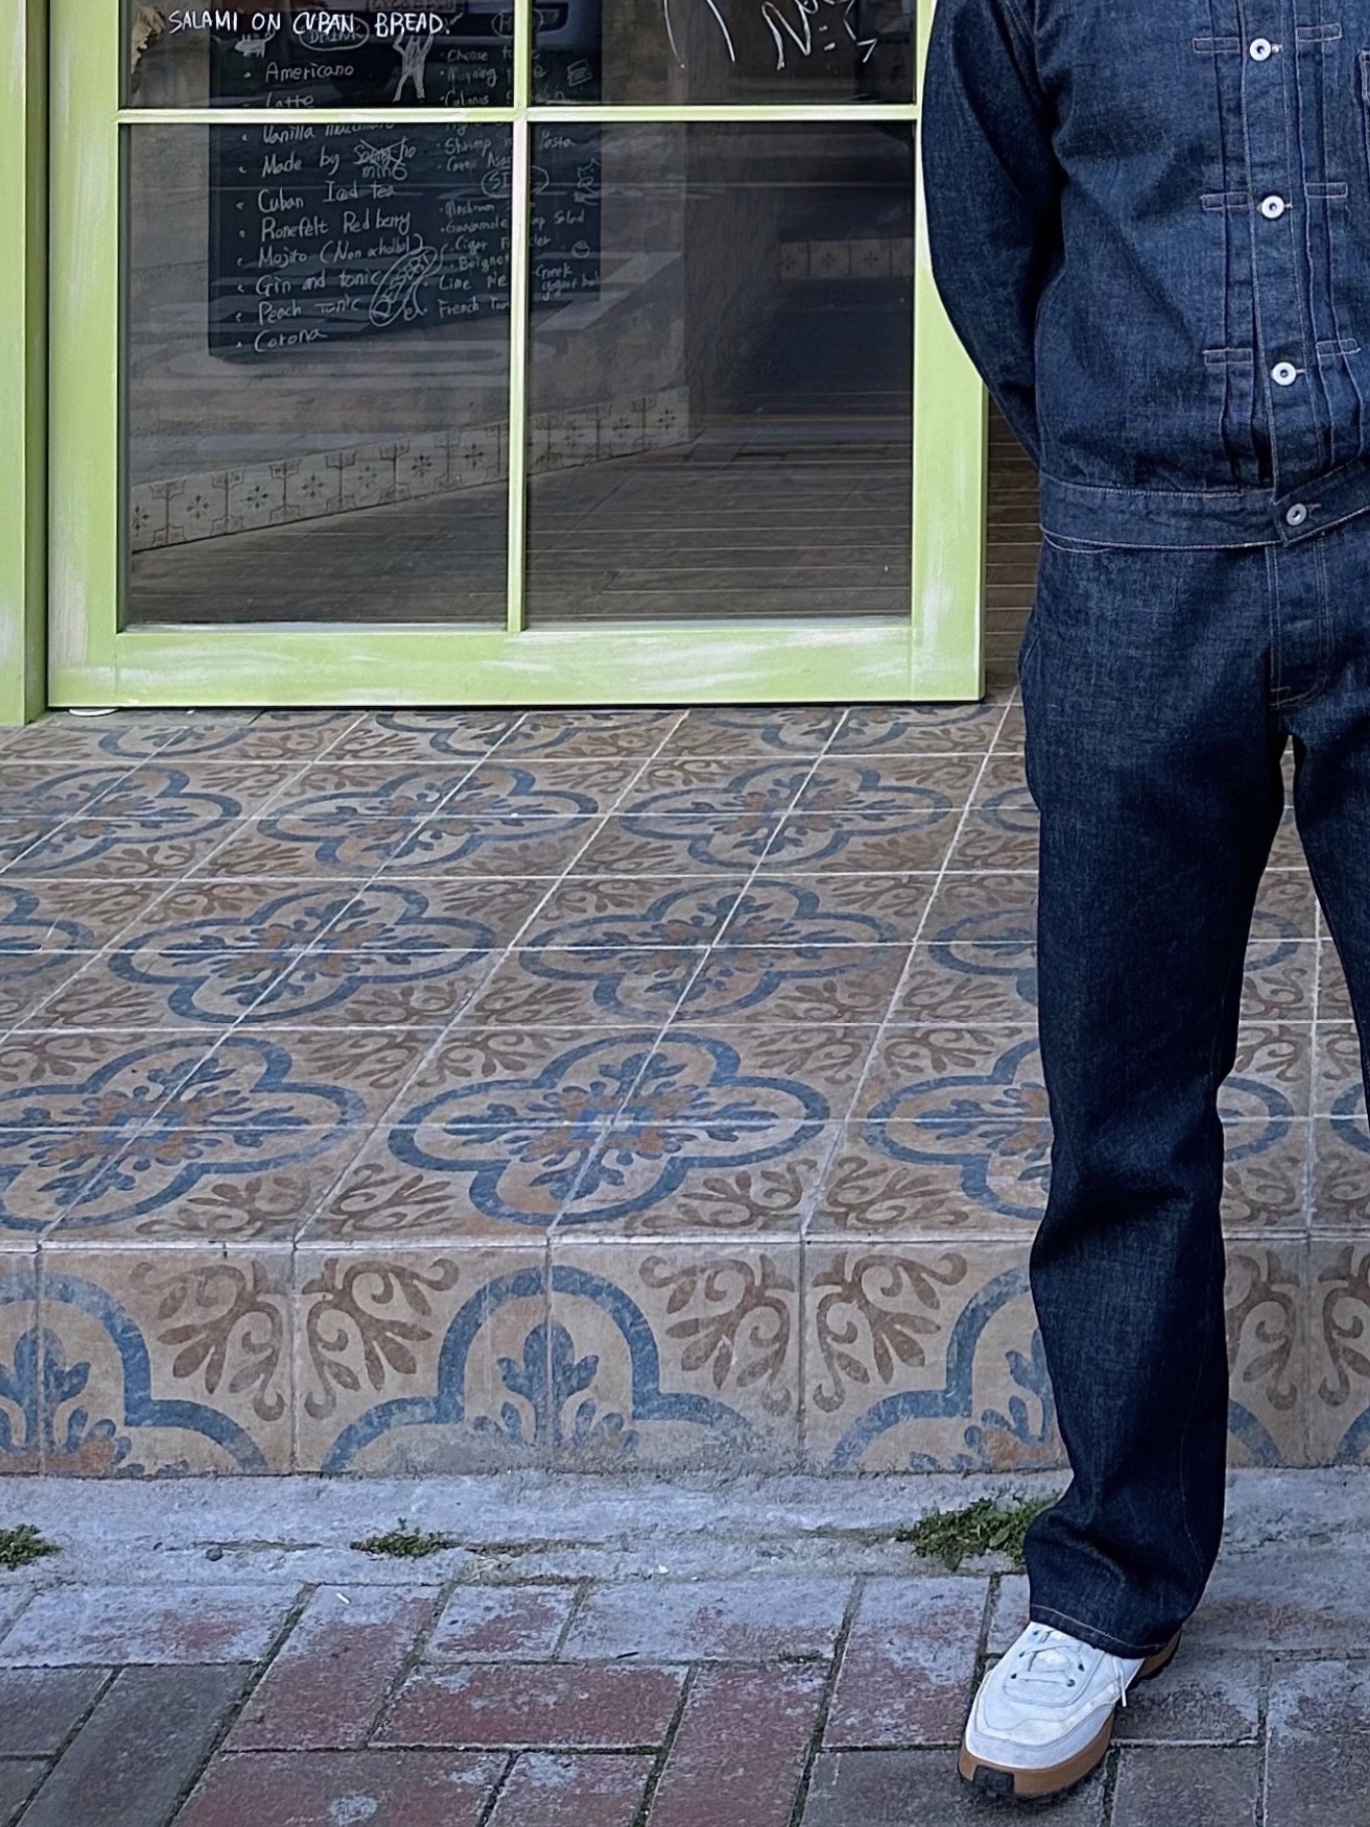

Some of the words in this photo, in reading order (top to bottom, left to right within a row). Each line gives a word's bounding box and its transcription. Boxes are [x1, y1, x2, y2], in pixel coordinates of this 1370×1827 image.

[168, 9, 238, 35] SALAMI
[251, 11, 281, 32] ON
[265, 61, 355, 83] Americano
[263, 125, 316, 144] Vanilla
[319, 144, 340, 177] by
[257, 187, 304, 214] Cuban
[342, 207, 370, 234] Red
[375, 207, 412, 236] berry
[257, 244, 308, 269] Mojito
[255, 273, 292, 298] Gin
[258, 298, 302, 326] Peach
[254, 328, 329, 353] Corona
